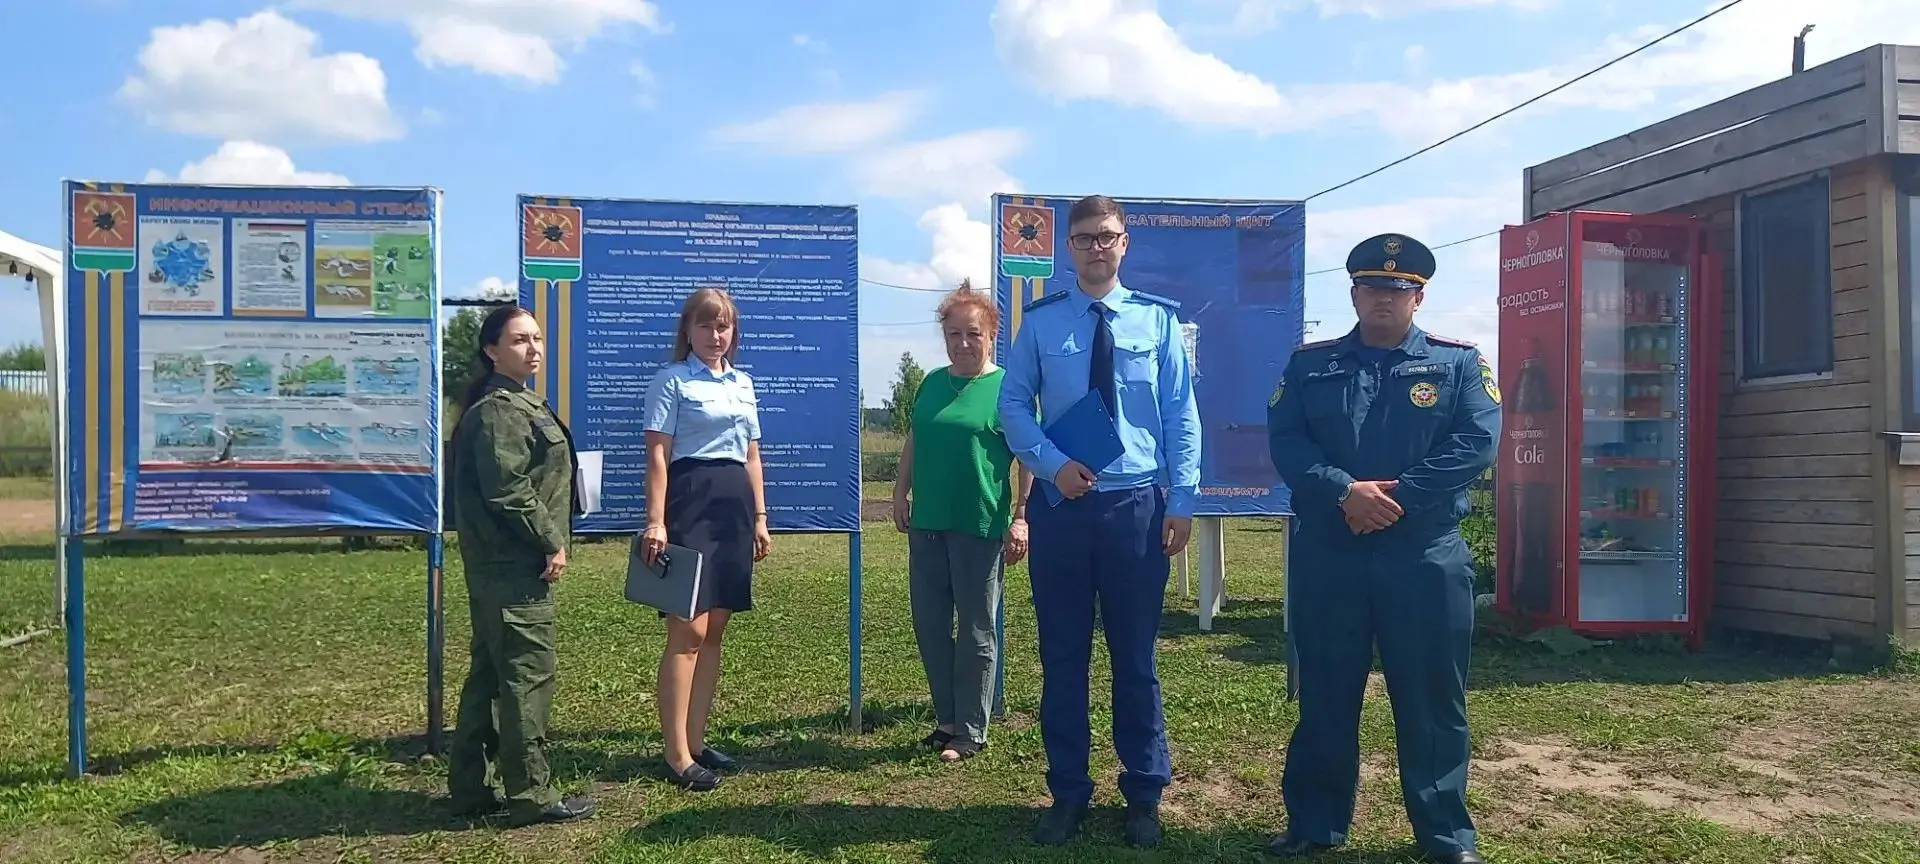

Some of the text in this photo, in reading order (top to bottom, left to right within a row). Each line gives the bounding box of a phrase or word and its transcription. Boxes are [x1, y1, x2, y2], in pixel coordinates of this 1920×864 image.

[150, 197, 428, 217] ИНФОРМАЦИОННЫЙ СТЕНД
[1125, 213, 1274, 229] САТЕЛЬНЫЙ ЩИТ
[1502, 246, 1564, 272] ЧЕРНОГОЛОВКА
[1596, 243, 1670, 259] ЧЕРНОГОЛОВКА
[1501, 288, 1550, 312] радость
[1530, 302, 1564, 314] ОСТАНОВКИ
[1514, 444, 1545, 464] Cola
